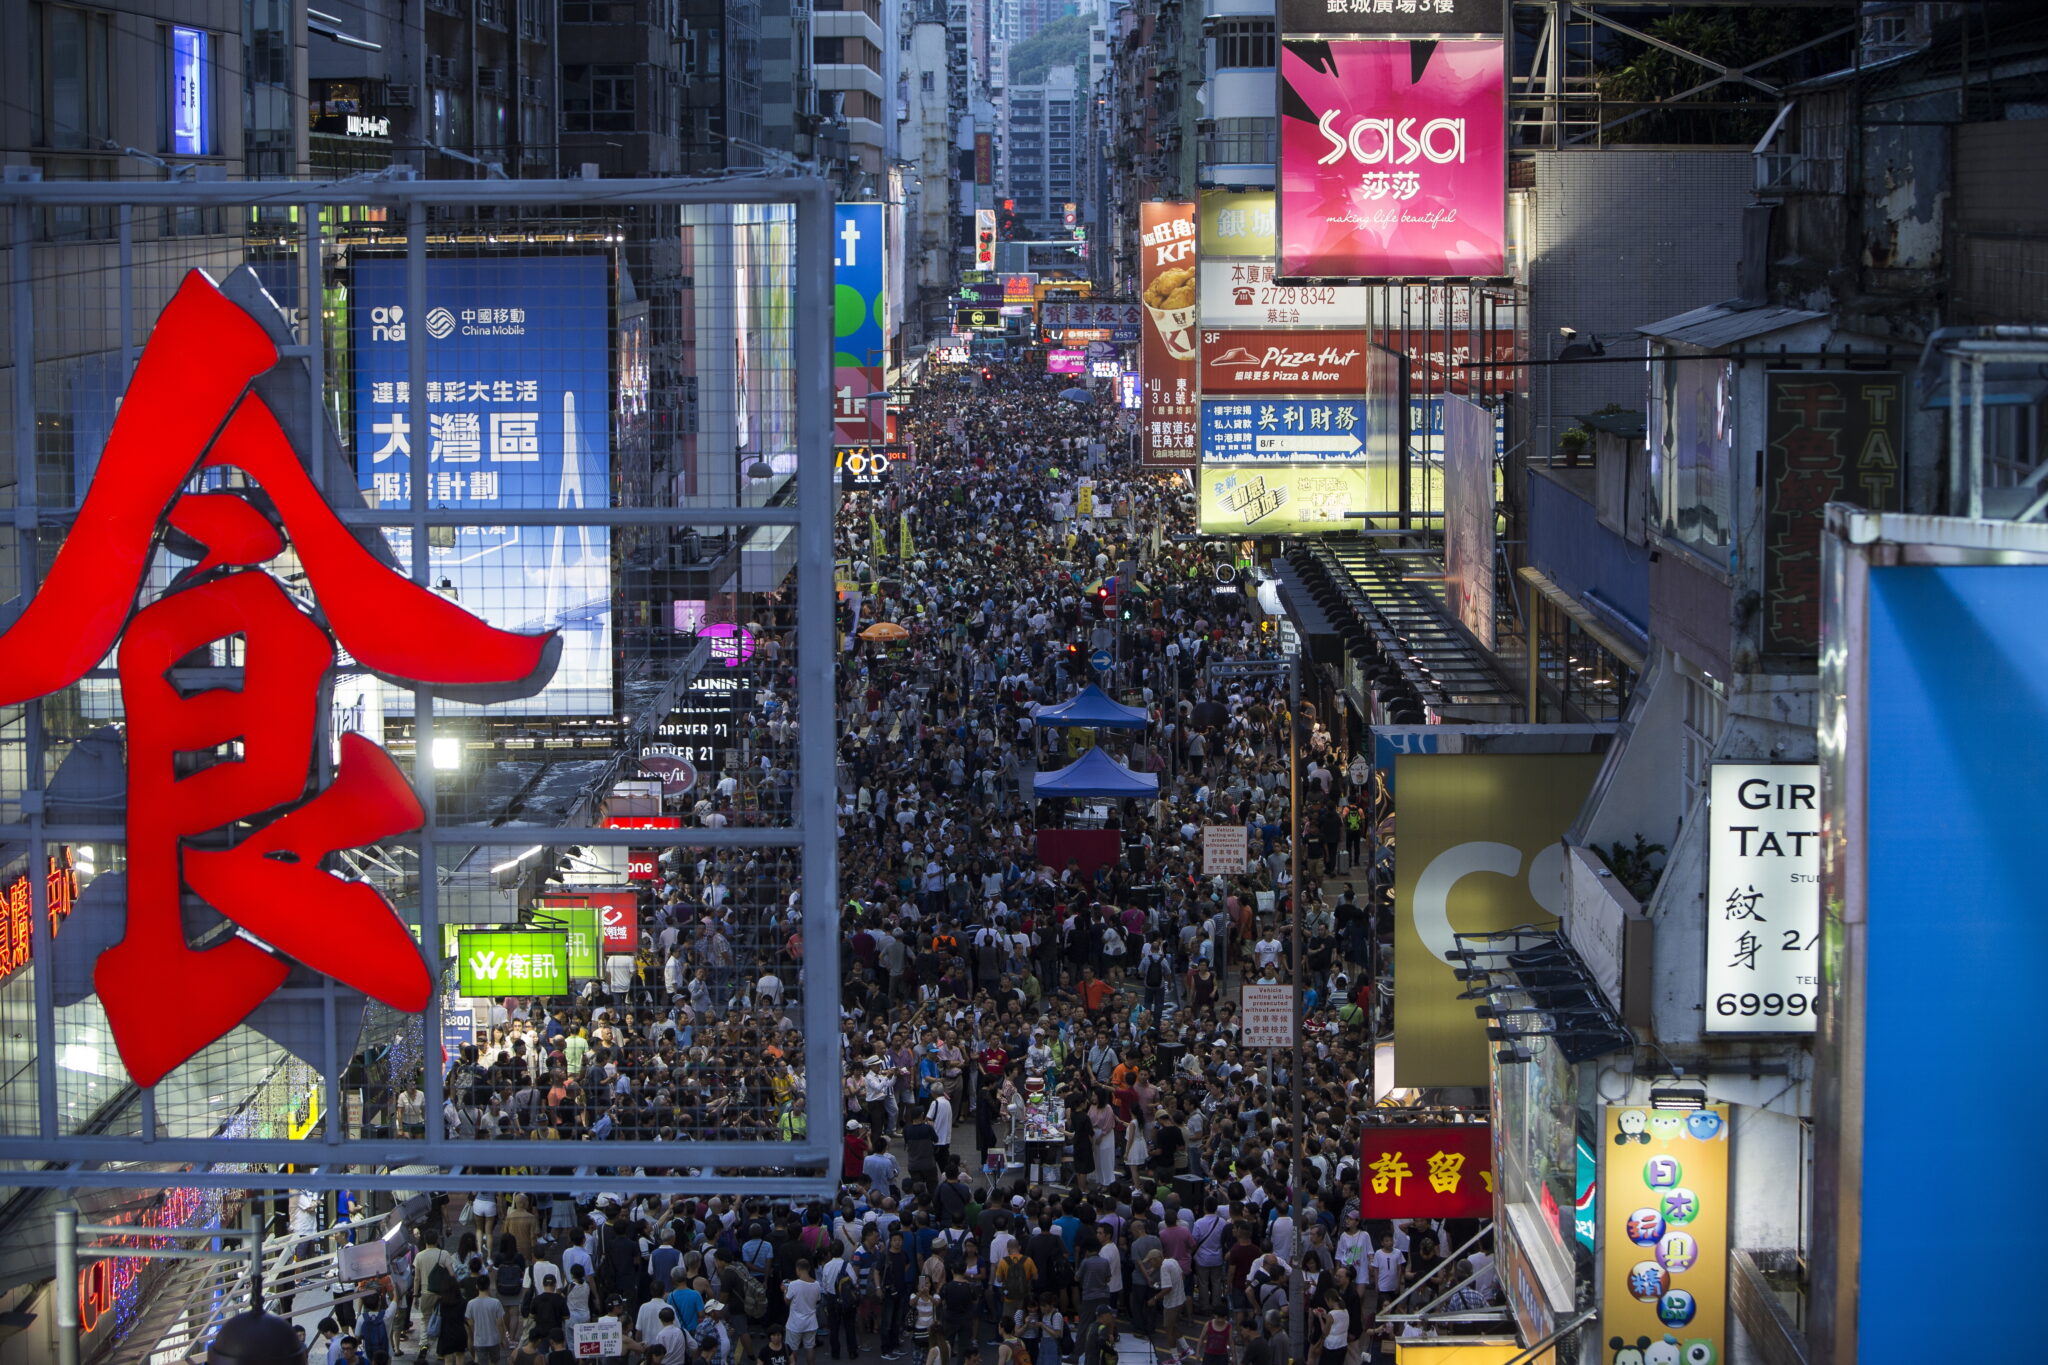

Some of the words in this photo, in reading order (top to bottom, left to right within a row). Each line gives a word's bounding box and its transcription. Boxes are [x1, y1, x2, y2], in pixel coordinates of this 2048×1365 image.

[1362, 171, 1420, 201] 莎莎
[1326, 208, 1373, 229] making
[1373, 208, 1399, 229] life
[1400, 208, 1457, 230] beautiful
[1261, 287, 1296, 305] 2729
[1300, 287, 1335, 305] 8342
[461, 308, 526, 324] 中國移動
[1267, 309, 1300, 323] 蔡生洽
[461, 325, 491, 336] China
[492, 325, 525, 336] Mobile
[1204, 333, 1221, 344] 3F
[1261, 347, 1316, 368] Pizza
[1318, 347, 1361, 367] Hut
[1272, 371, 1299, 381] Pizza
[1301, 372, 1310, 381] &
[1317, 371, 1340, 381] More
[1257, 404, 1359, 432] 英利財務
[372, 412, 540, 464] 大灣區
[1260, 440, 1275, 448] 8/F
[1214, 474, 1238, 497] 全新
[0, 268, 558, 1088] 食
[714, 723, 728, 737] 21
[700, 747, 714, 761] 21
[1725, 885, 1768, 971] 紋身
[504, 953, 559, 980] 衛訊
[1252, 1015, 1288, 1023] 停車等候
[1252, 1025, 1288, 1034] 會被檢控
[1368, 1150, 1492, 1197] 許留
[1627, 1160, 1692, 1320] 日本玩具精品
